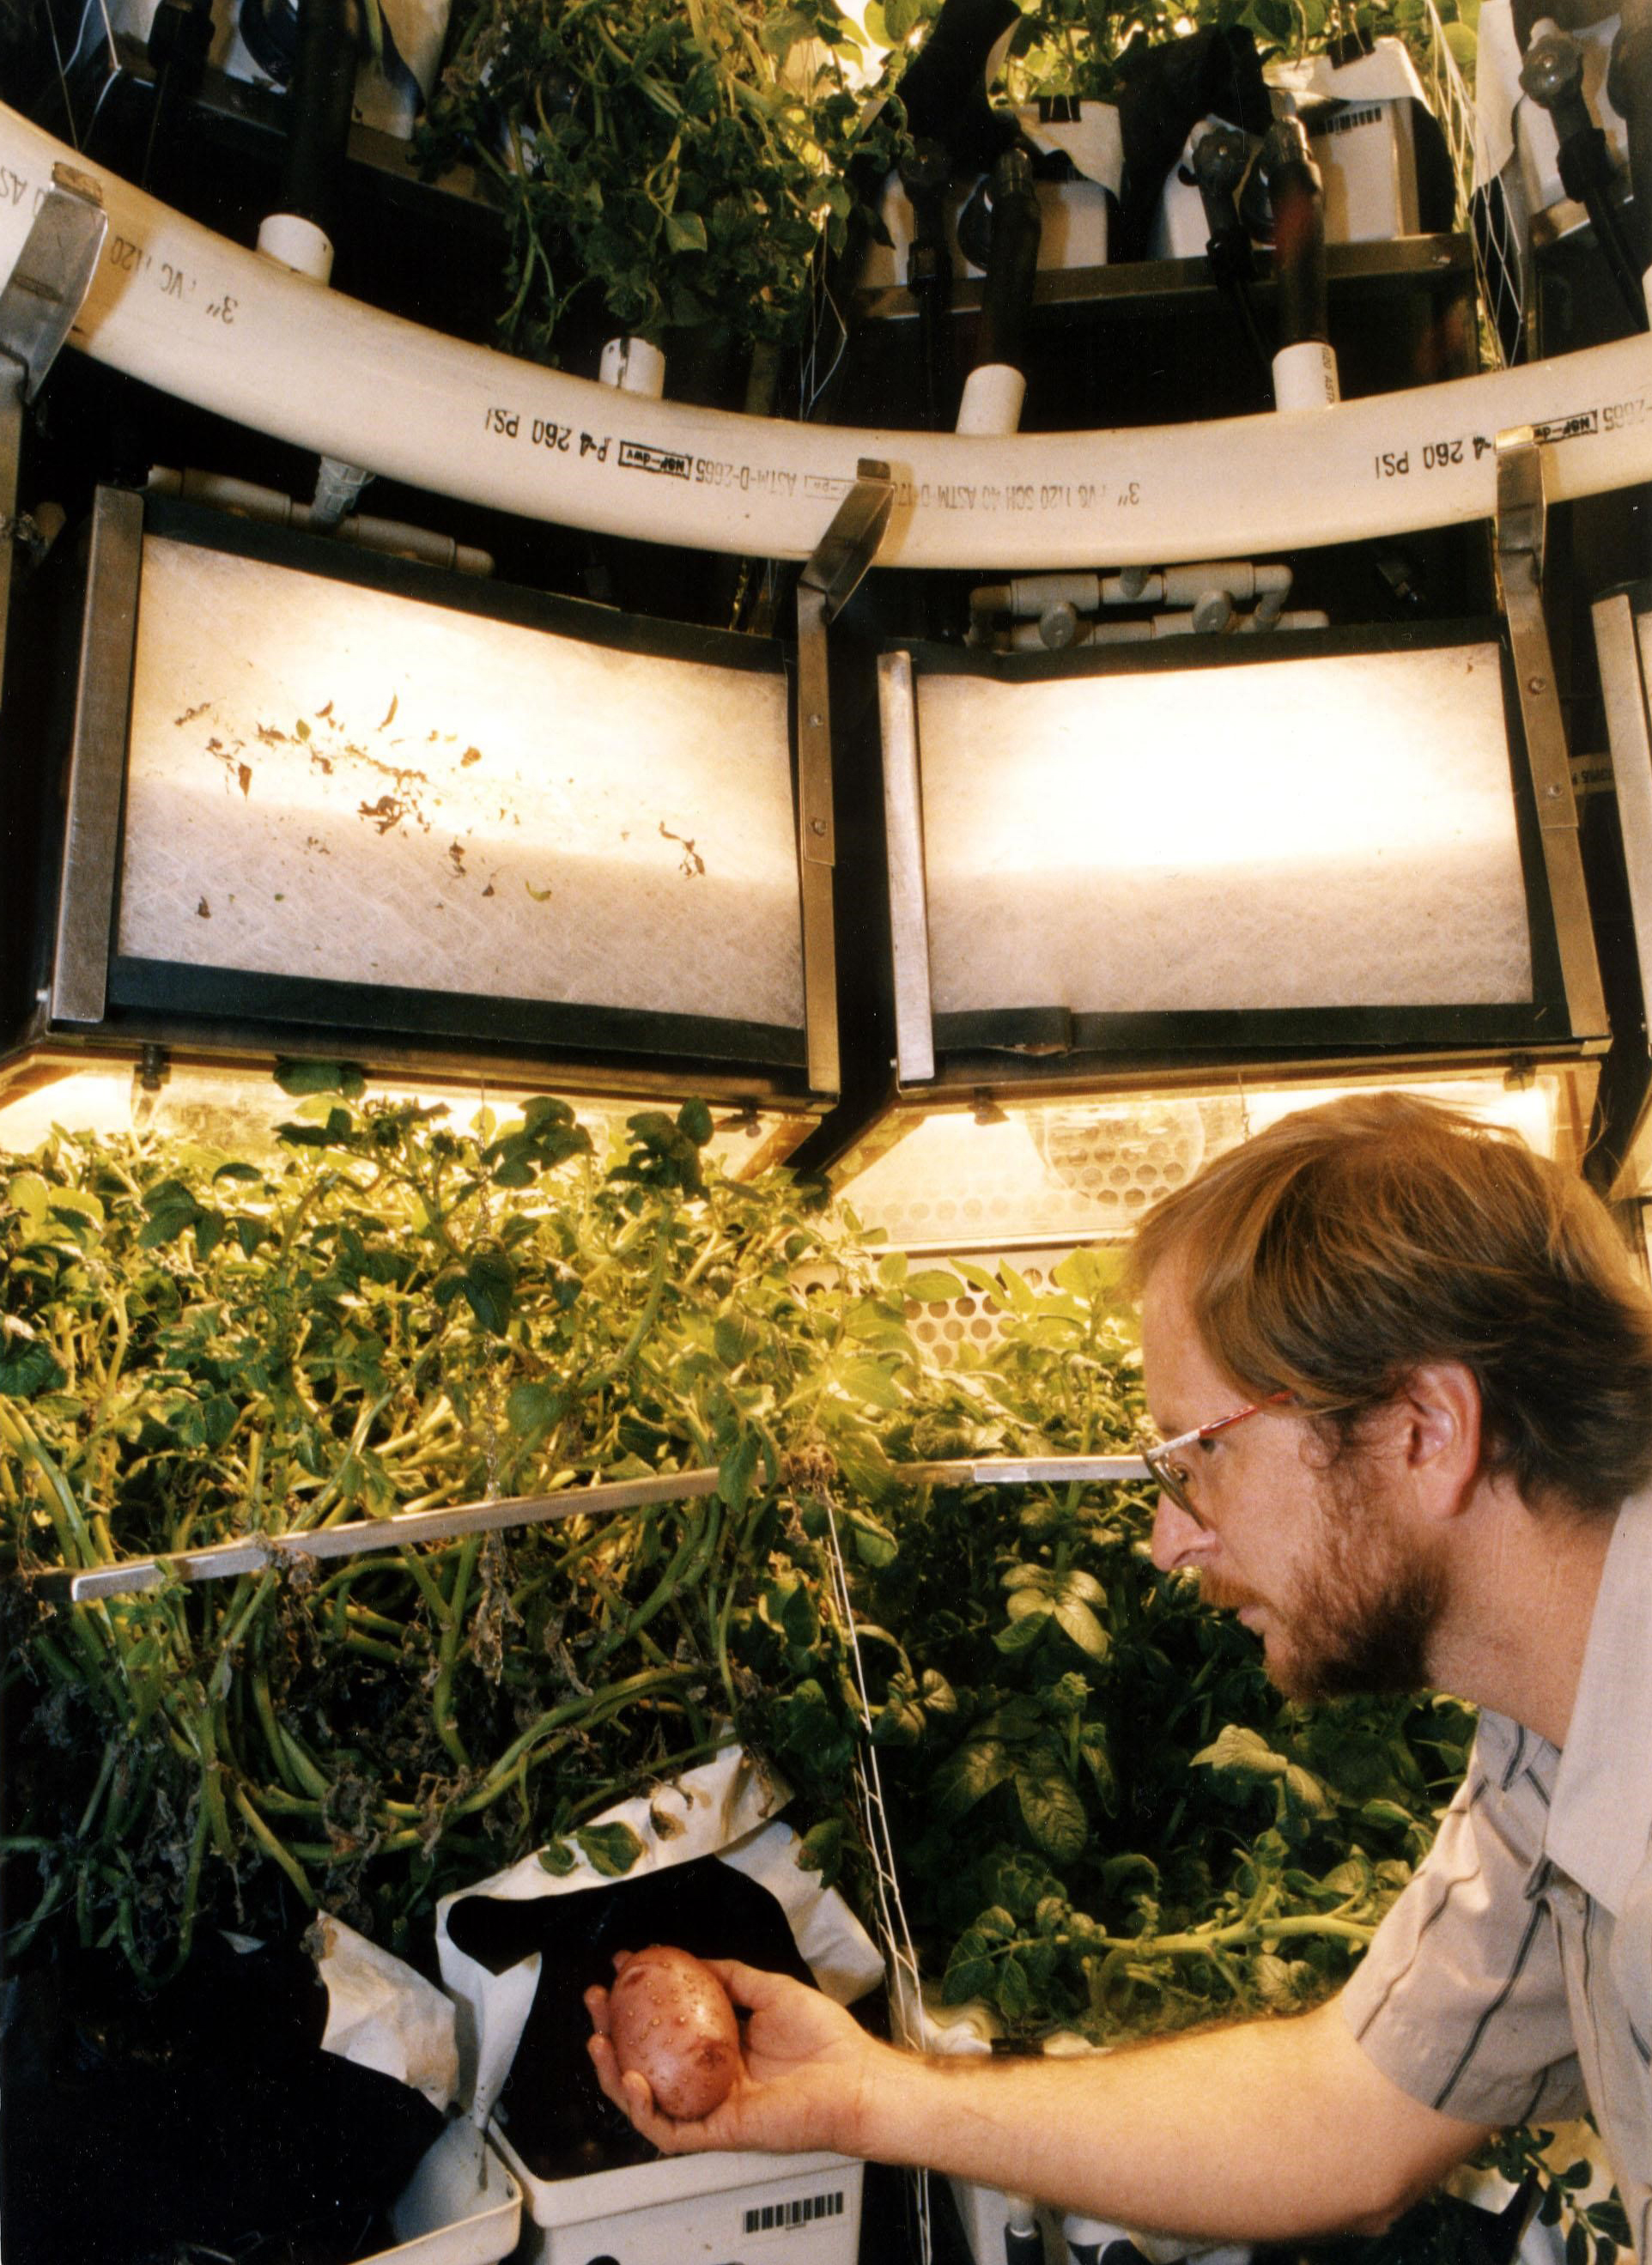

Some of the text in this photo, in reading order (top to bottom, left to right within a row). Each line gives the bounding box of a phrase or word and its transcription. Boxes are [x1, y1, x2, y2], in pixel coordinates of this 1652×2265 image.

[484, 408, 519, 438] PSI
[531, 420, 572, 449] 260
[580, 433, 612, 462] P-4
[1423, 440, 1463, 470] 260
[1375, 451, 1410, 480] PSI
[1005, 485, 1035, 513] SCH
